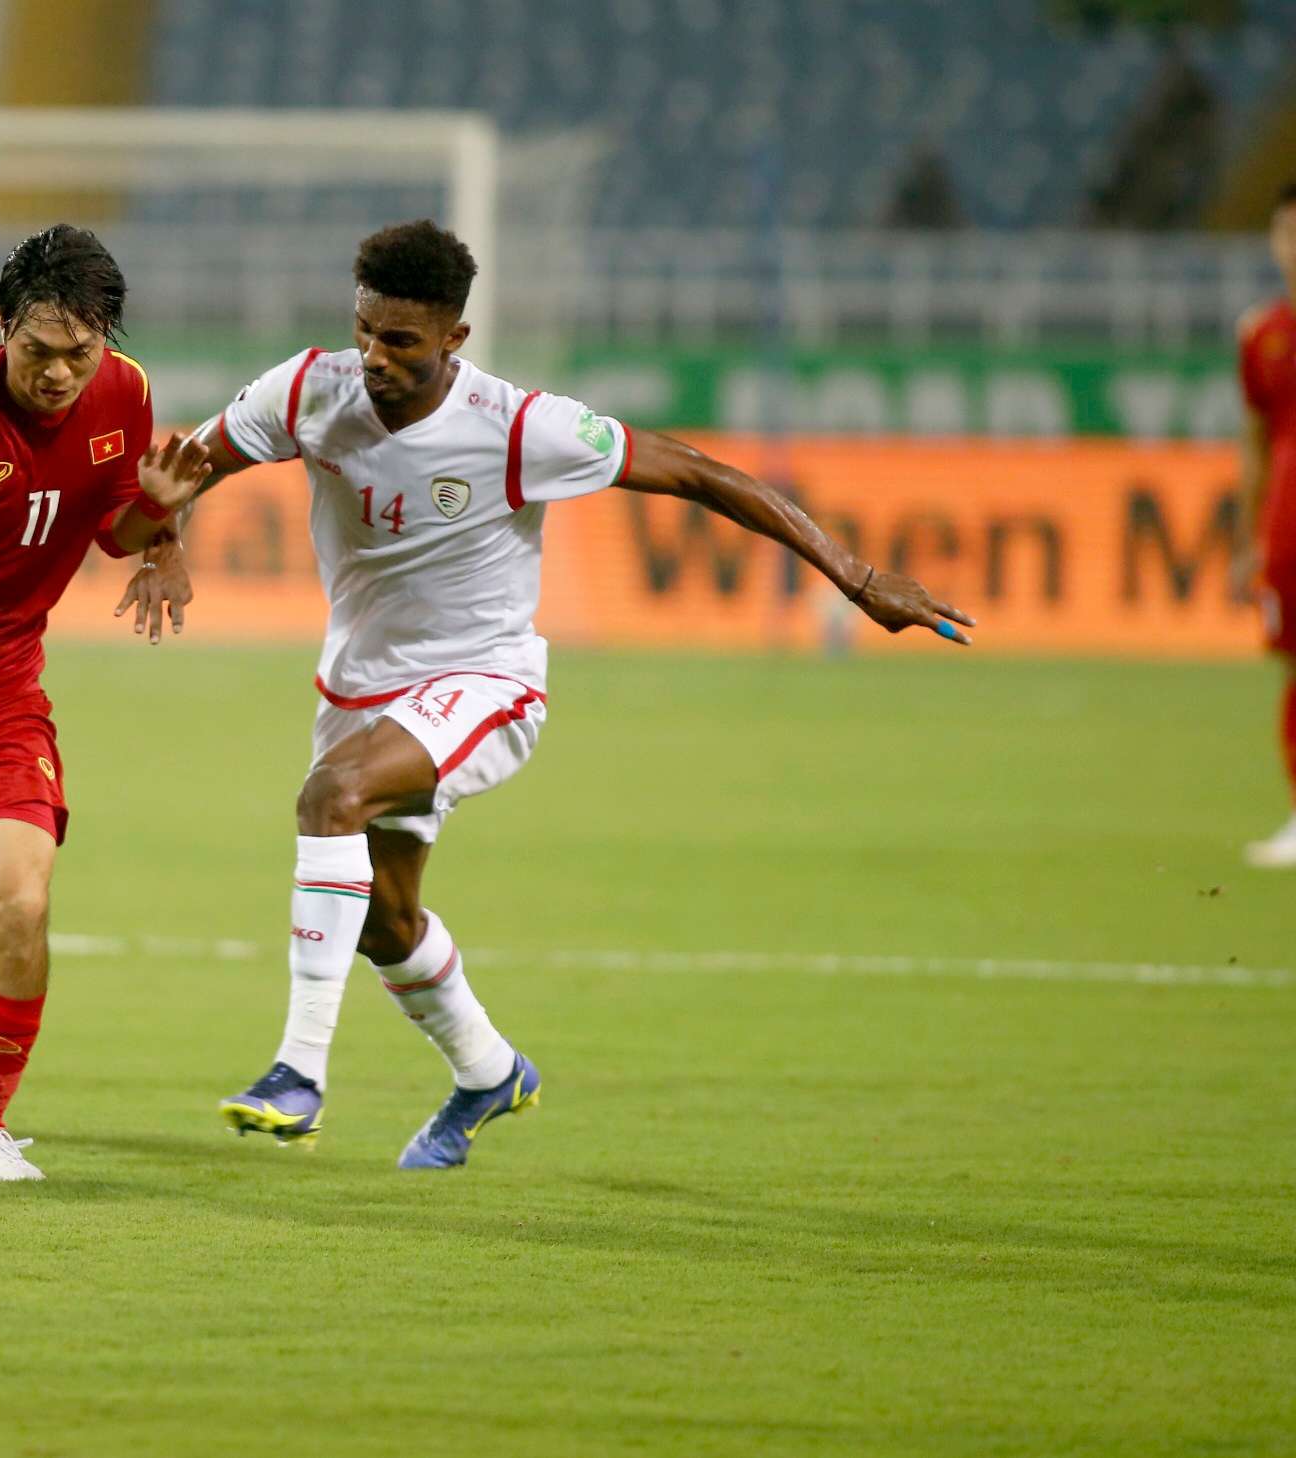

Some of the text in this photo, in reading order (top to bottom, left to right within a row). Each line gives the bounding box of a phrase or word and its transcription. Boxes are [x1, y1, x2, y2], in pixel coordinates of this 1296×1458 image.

[20, 489, 61, 547] 11
[359, 485, 405, 535] 14
[407, 680, 464, 722] 14
[407, 699, 441, 728] JAKO
